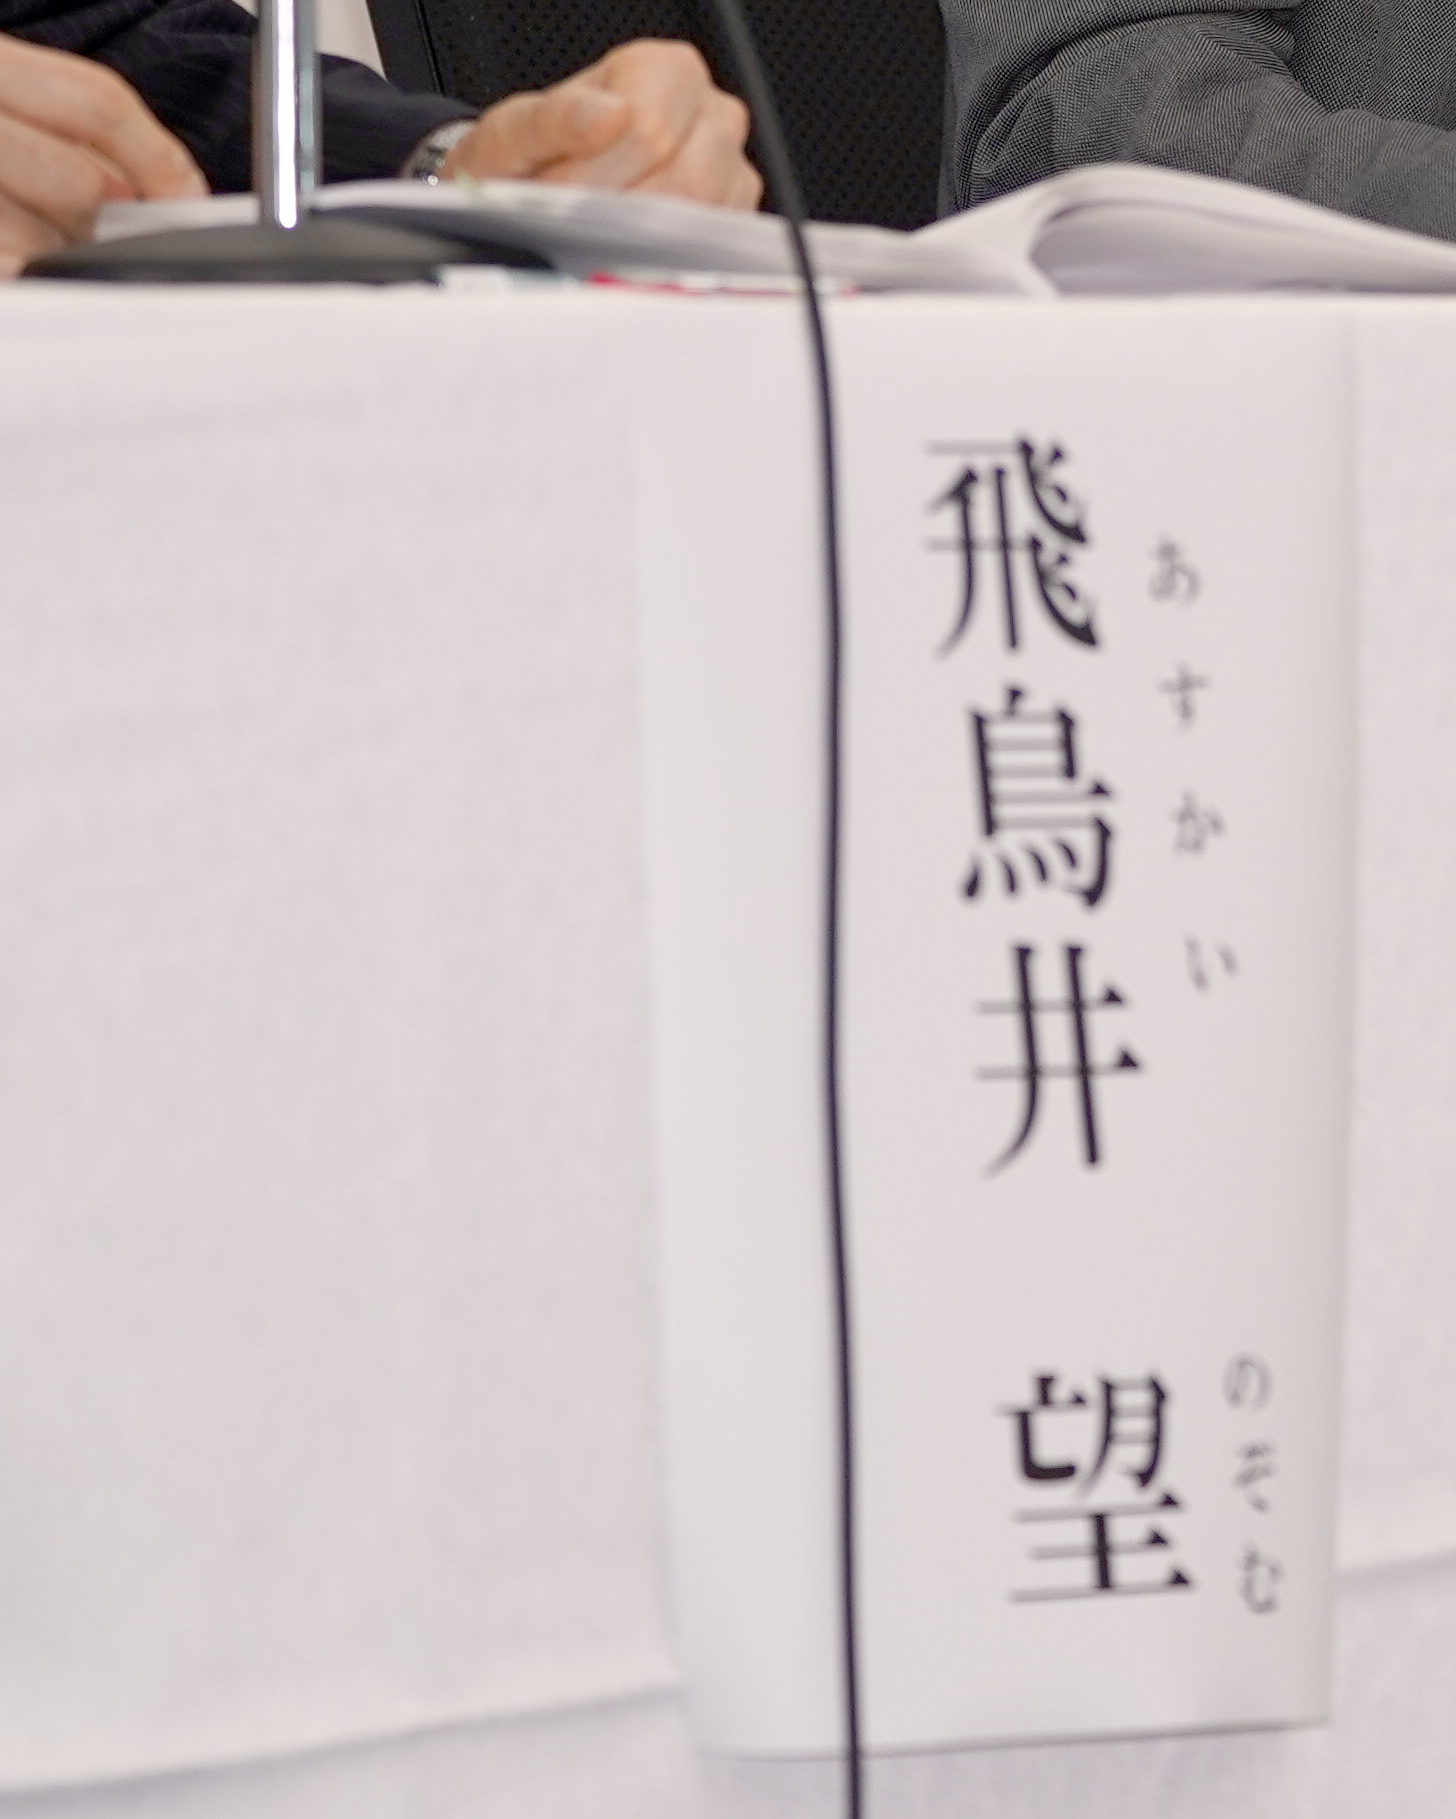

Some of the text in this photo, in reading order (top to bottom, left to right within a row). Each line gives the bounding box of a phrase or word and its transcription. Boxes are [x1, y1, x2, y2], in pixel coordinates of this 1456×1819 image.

[922, 435, 1197, 1605] 飛鳥井 望
[1147, 535, 1239, 993] あすかい
